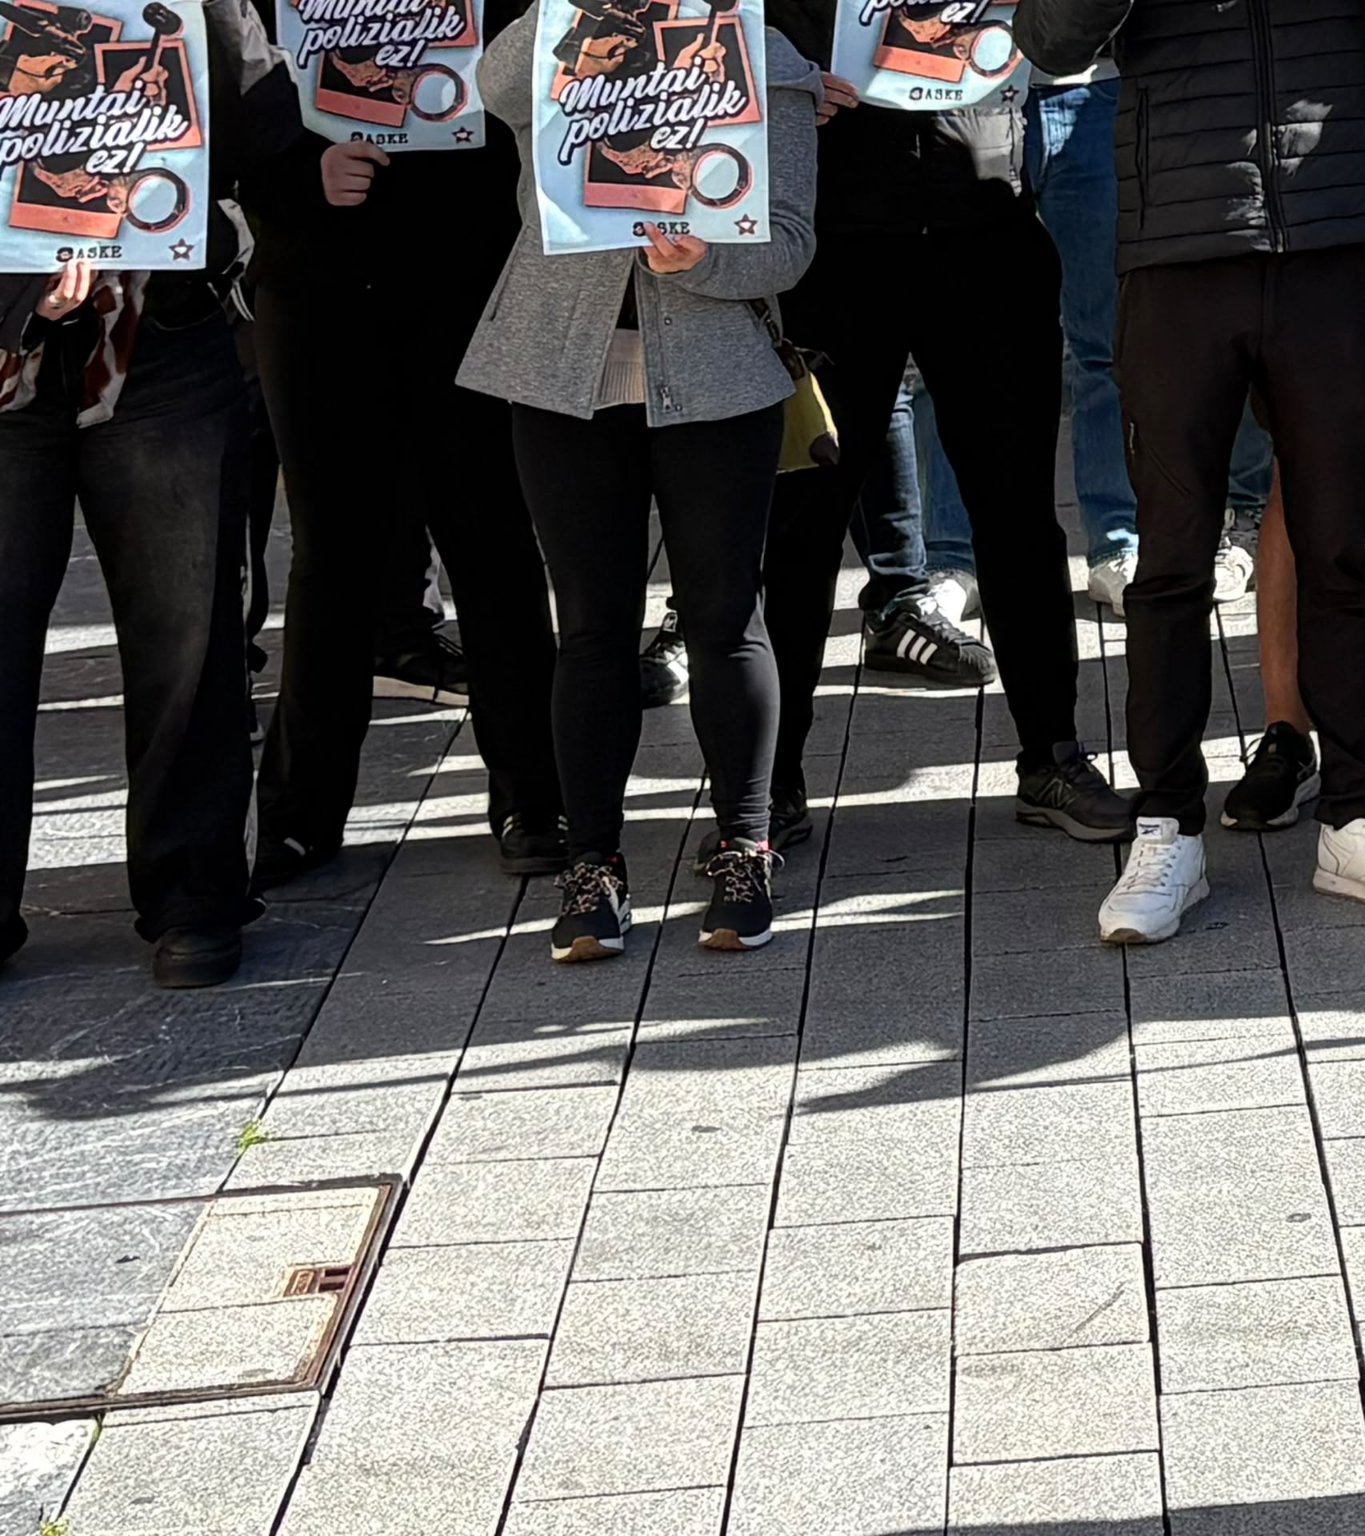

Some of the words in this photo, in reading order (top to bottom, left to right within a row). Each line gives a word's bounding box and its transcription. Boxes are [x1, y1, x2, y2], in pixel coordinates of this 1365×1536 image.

[297, 6, 464, 66] polizialik
[378, 41, 424, 66] ez!
[560, 57, 705, 110] Muntai
[925, 88, 964, 100] ASKE
[0, 80, 145, 128] Muntai
[559, 81, 745, 162] polizialik
[652, 120, 704, 149] ez!
[88, 143, 143, 172] ez!
[656, 223, 691, 237] SKE
[78, 248, 122, 261] ASKE
